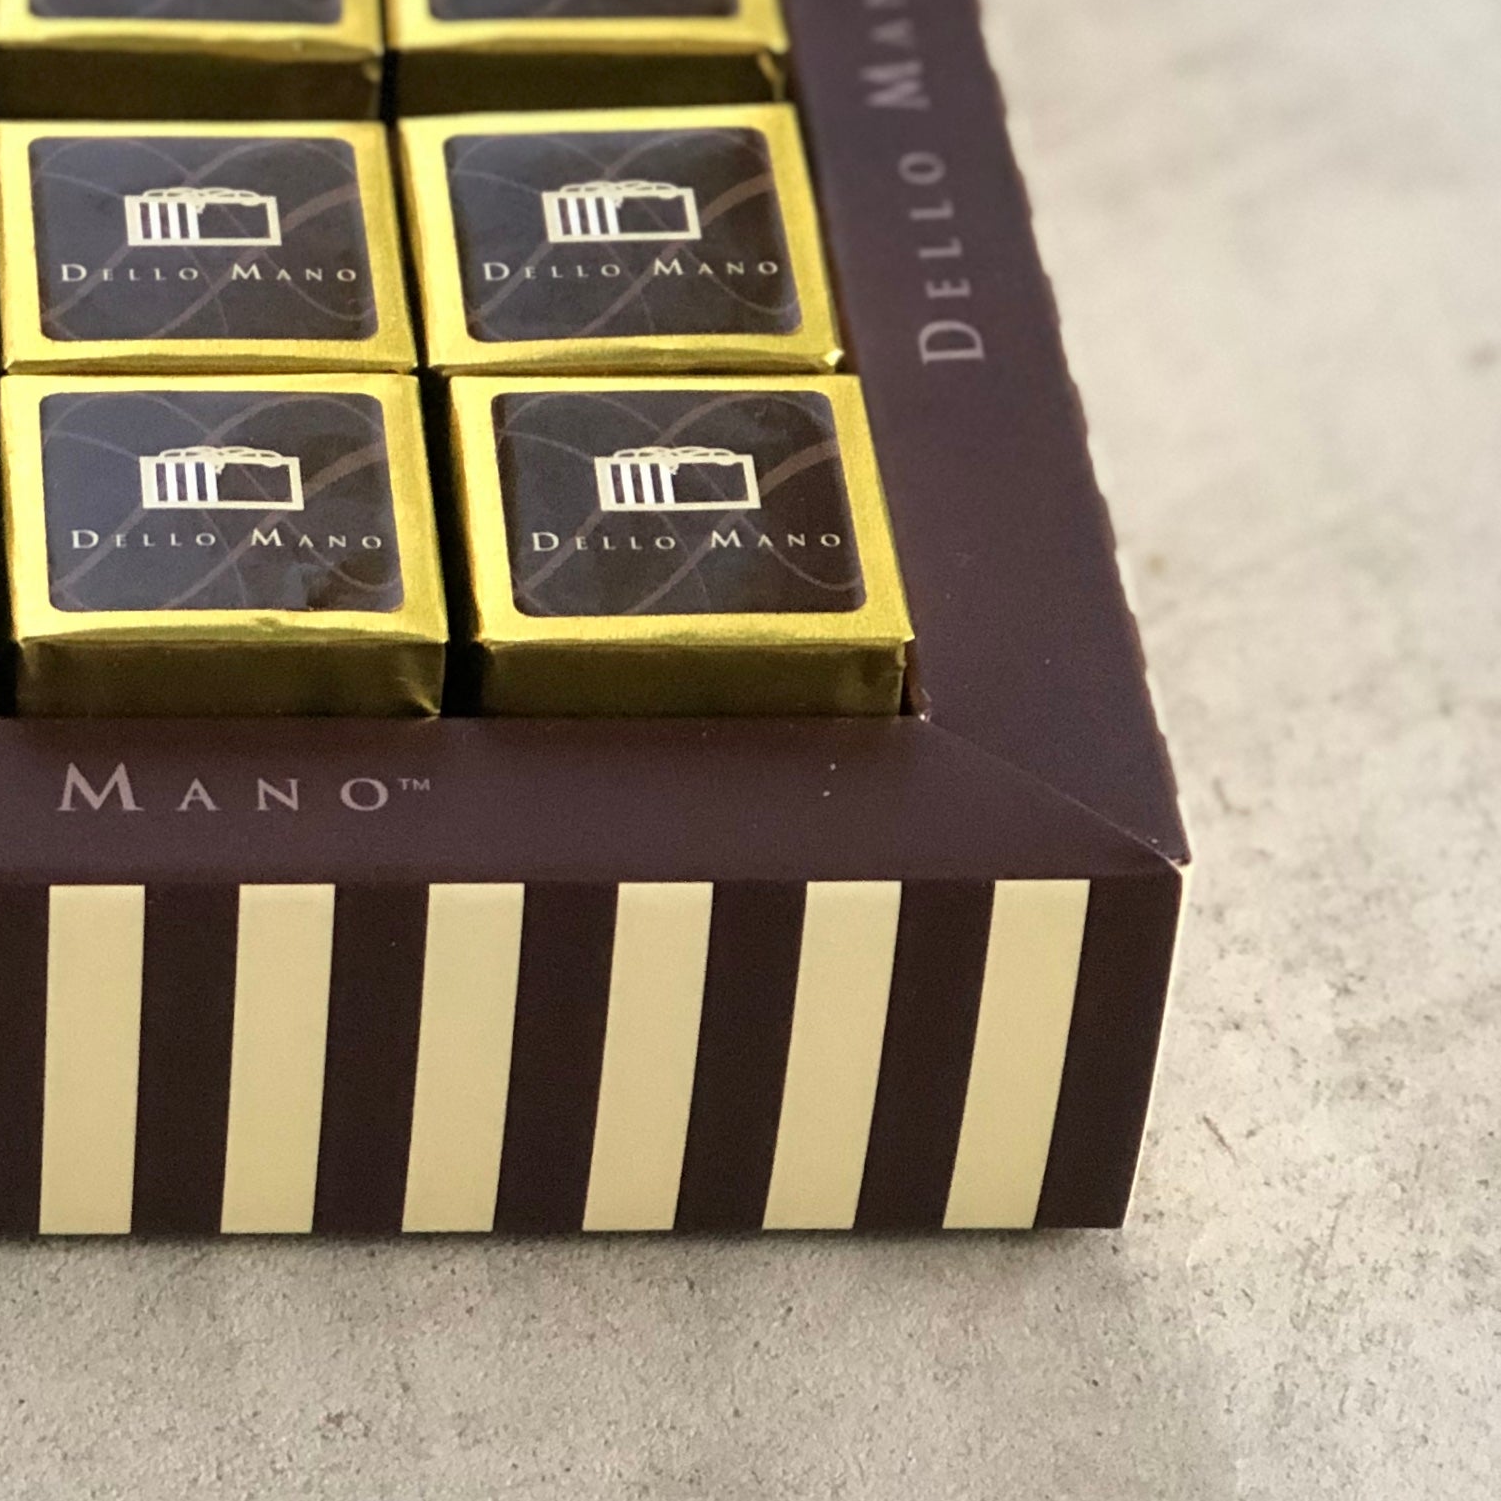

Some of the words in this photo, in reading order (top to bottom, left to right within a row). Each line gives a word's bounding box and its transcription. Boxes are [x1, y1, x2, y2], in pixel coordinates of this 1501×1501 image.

[482, 260, 622, 282] DELLO
[652, 256, 779, 277] MANO
[897, 151, 986, 366] DELLO
[60, 262, 200, 283] DELLO
[230, 261, 358, 283] MANO
[70, 527, 217, 550] DELLO
[250, 526, 384, 550] MANO
[531, 530, 677, 553] DELLO
[709, 528, 843, 550] MANO
